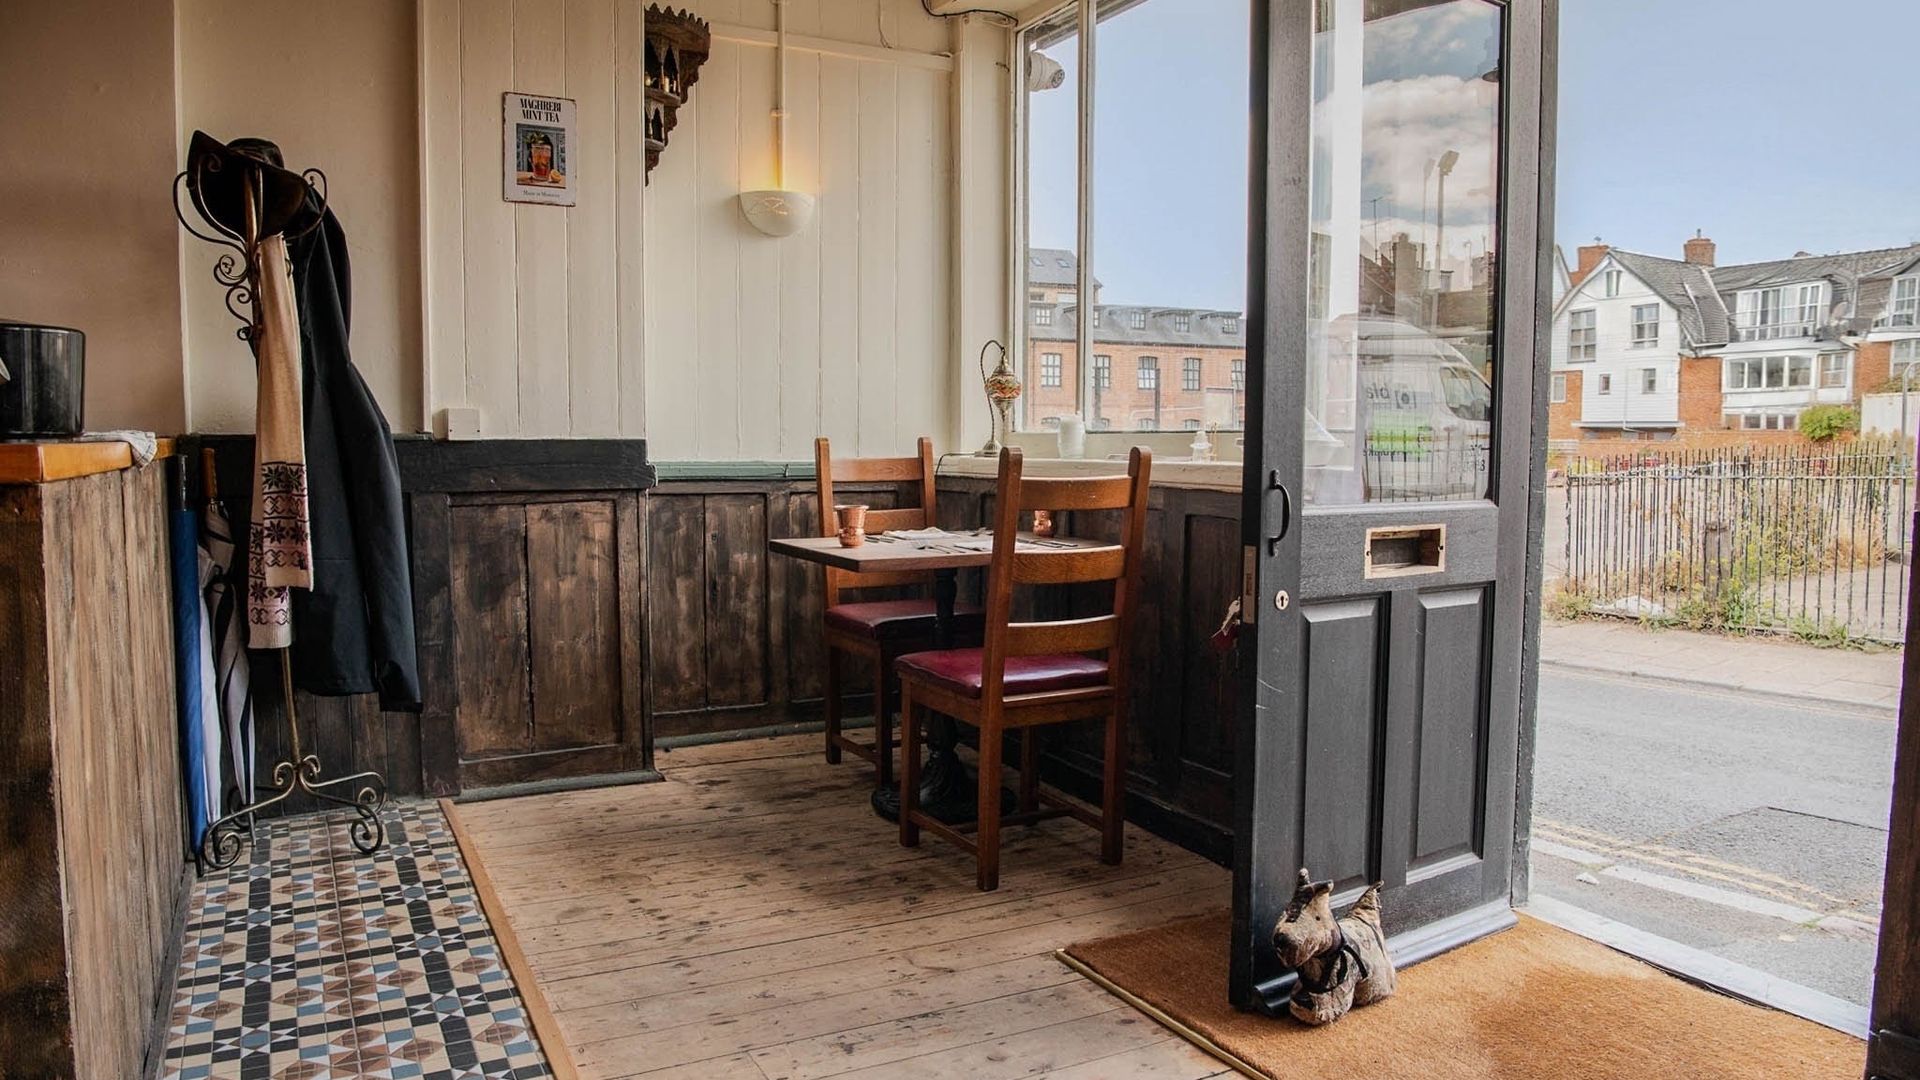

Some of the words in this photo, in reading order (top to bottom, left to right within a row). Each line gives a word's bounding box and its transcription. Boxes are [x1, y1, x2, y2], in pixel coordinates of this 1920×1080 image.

[520, 98, 561, 112] MAGHREBI
[522, 109, 541, 120] MINT
[544, 112, 559, 123] TEA
